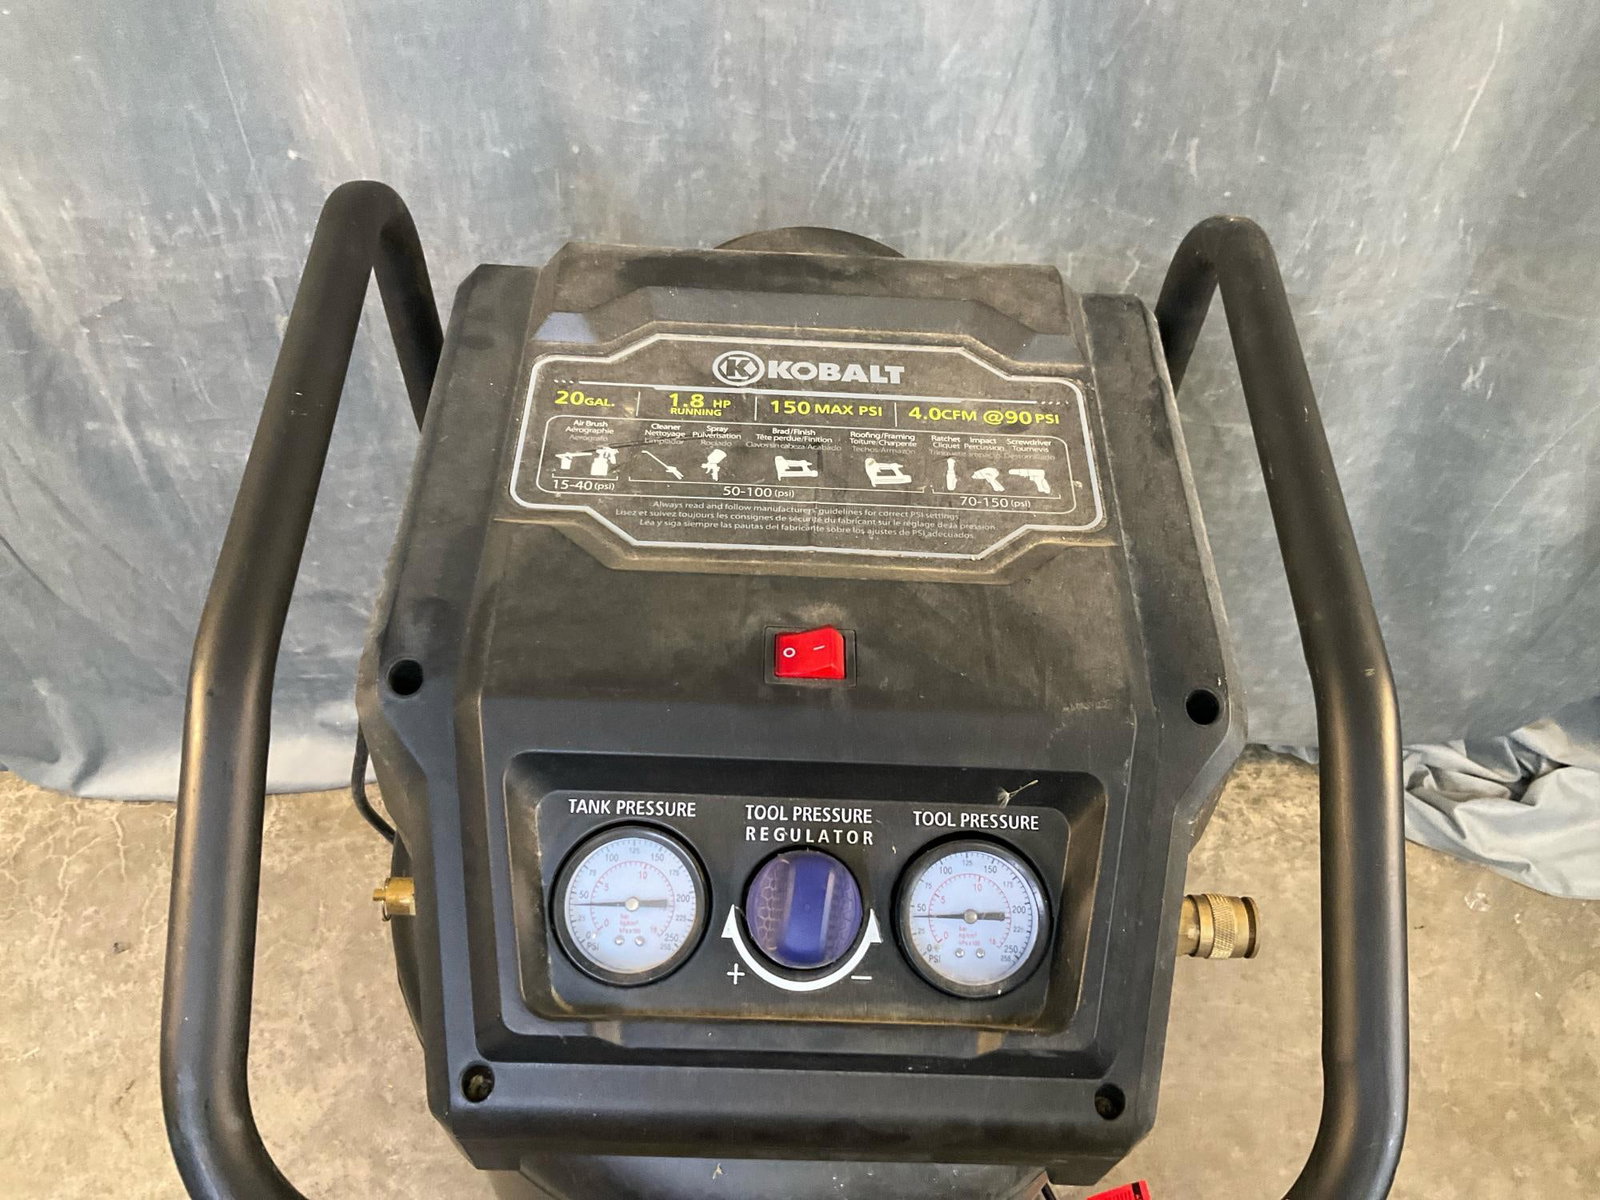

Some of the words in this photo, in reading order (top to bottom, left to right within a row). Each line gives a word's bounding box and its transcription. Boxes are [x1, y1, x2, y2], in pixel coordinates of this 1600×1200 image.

[768, 360, 905, 384] KOBALT
[668, 393, 704, 408] 1.8
[712, 400, 731, 409] HP
[670, 407, 722, 417] RUNNING
[771, 400, 811, 415] 150
[814, 404, 854, 416] MAX
[858, 405, 883, 417] PSI
[908, 406, 977, 422] 4.0CFM
[983, 410, 1033, 425] @90
[1035, 413, 1060, 424] PSI
[586, 420, 608, 428] Brush
[651, 423, 682, 431] Cleaner
[644, 430, 686, 438] Nettoyage
[706, 425, 729, 434] Spray
[772, 427, 816, 436] Brad/Finish
[850, 431, 916, 442] Roofing/Framing
[931, 435, 961, 443] Ratchet
[932, 442, 960, 450] Cliquet
[970, 437, 998, 446] Impact
[1006, 438, 1052, 447] Screwdriver
[964, 444, 1005, 452] Percussion
[552, 479, 593, 491] 15-40
[594, 482, 615, 491] (psi)
[723, 486, 772, 498] 50-100
[774, 489, 795, 498] (psi)
[960, 496, 1009, 508] 70-150
[1010, 500, 1031, 508] (psi)
[652, 501, 683, 510] Always
[685, 502, 704, 510] read
[725, 503, 752, 511] follow
[818, 508, 863, 516] guidelines
[878, 510, 908, 518] correct
[616, 508, 637, 516] Lisez
[678, 510, 714, 520] toujours
[730, 513, 774, 522] consignes
[838, 517, 877, 526] fabricant
[656, 520, 662, 528] y
[664, 520, 682, 528] siga
[684, 520, 718, 529] siempre
[734, 522, 764, 530] pautas
[780, 524, 824, 532] fabricante
[866, 528, 897, 536] ajustes
[568, 798, 611, 814] TANK
[616, 800, 697, 818] PRESSURE
[745, 804, 788, 821] TOOL
[792, 807, 873, 824] PRESSURE
[912, 810, 956, 827] TOOL
[960, 812, 1040, 830] PRESSURE
[745, 826, 874, 846] REGULATOR
[605, 853, 619, 862] 100
[651, 853, 665, 862] 150
[939, 866, 952, 874] 100
[984, 866, 998, 874] 150
[638, 871, 648, 880] 10
[973, 883, 982, 892] 10
[579, 891, 589, 900] 50
[676, 893, 691, 903] 200
[917, 904, 926, 912] 50
[1012, 905, 1026, 914] 200
[664, 934, 679, 942] 250
[944, 932, 949, 940] 0
[926, 944, 932, 952] 0
[1004, 945, 1018, 954] 250
[928, 954, 941, 964] PSI
